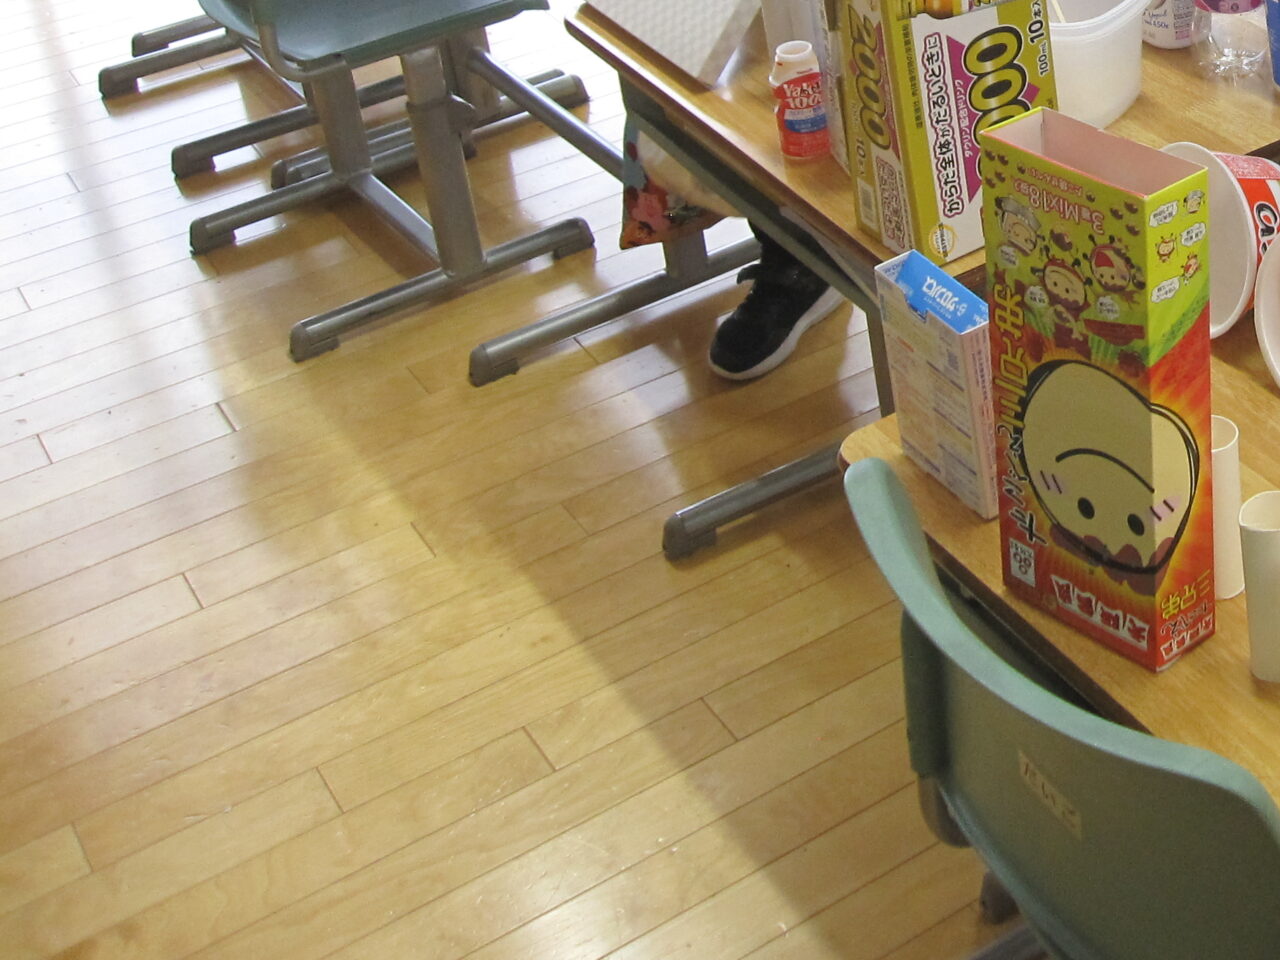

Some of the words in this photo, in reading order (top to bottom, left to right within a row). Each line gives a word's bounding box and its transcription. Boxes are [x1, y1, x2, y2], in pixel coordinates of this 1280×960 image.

[848, 2, 892, 151] 2000
[925, 34, 963, 216] からだ全体がだるいときに
[954, 78, 973, 158] タウリン配合ドリンク
[962, 25, 1032, 182] 000
[1162, 569, 1212, 620] 三兄弟
